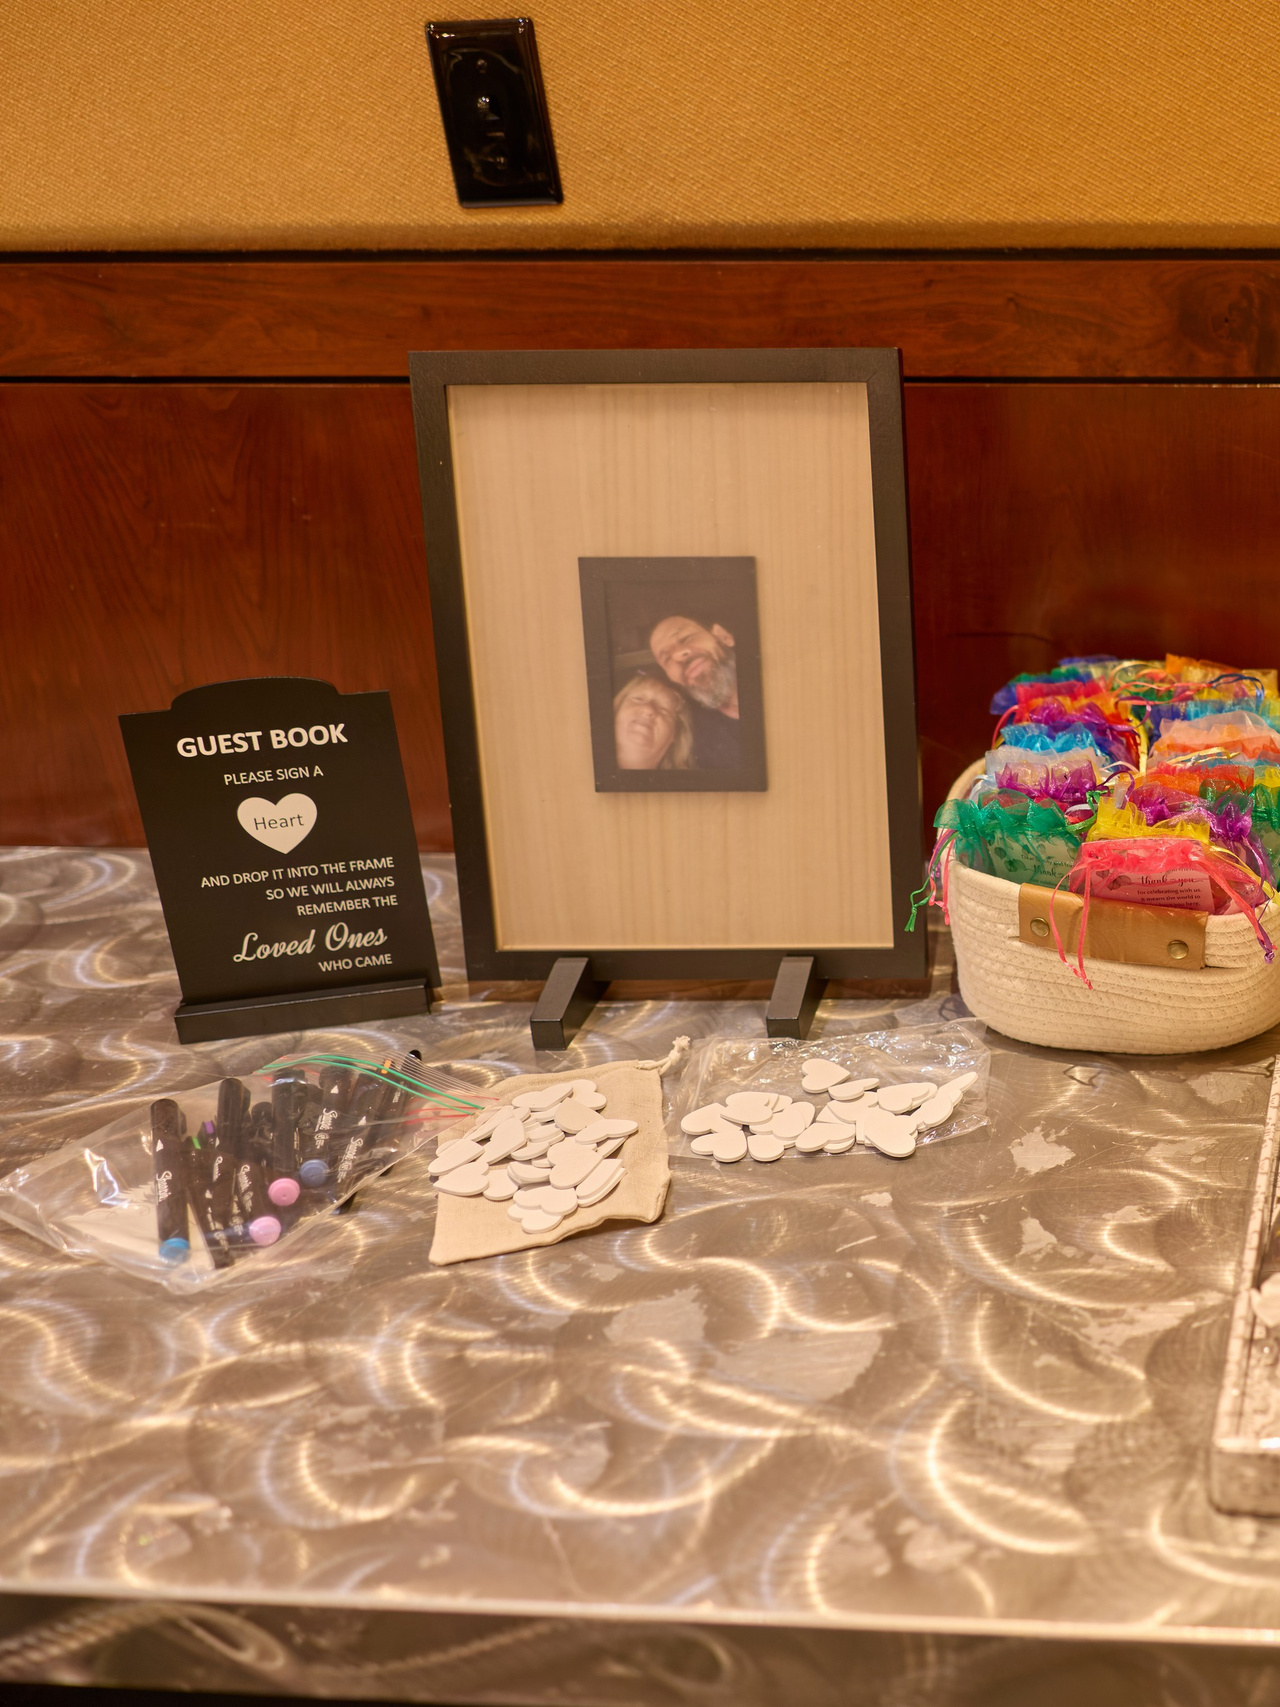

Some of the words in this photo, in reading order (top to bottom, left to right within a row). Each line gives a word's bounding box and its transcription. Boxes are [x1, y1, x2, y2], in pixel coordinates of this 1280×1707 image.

[176, 731, 263, 758] GUEST
[269, 723, 348, 749] BOOK
[223, 770, 274, 785] PLEASE
[276, 766, 310, 780] SIGN
[313, 765, 324, 777] A
[253, 814, 304, 831] Heart
[201, 875, 230, 888] AND
[233, 870, 269, 885] DROP
[272, 868, 284, 880] IT
[287, 865, 319, 879] INTO
[320, 862, 347, 875] THE
[349, 856, 395, 872] FRAME
[1141, 874, 1168, 885] thank
[265, 888, 284, 900] SO
[286, 885, 309, 898] WE
[311, 882, 343, 895] WILL
[345, 876, 395, 891] ALWAYS
[296, 899, 370, 916] REMEMBER
[371, 894, 398, 907] THE
[233, 929, 316, 963] Loved
[325, 921, 388, 951] Ones
[318, 958, 352, 972] WHO
[355, 953, 393, 968] CAME
